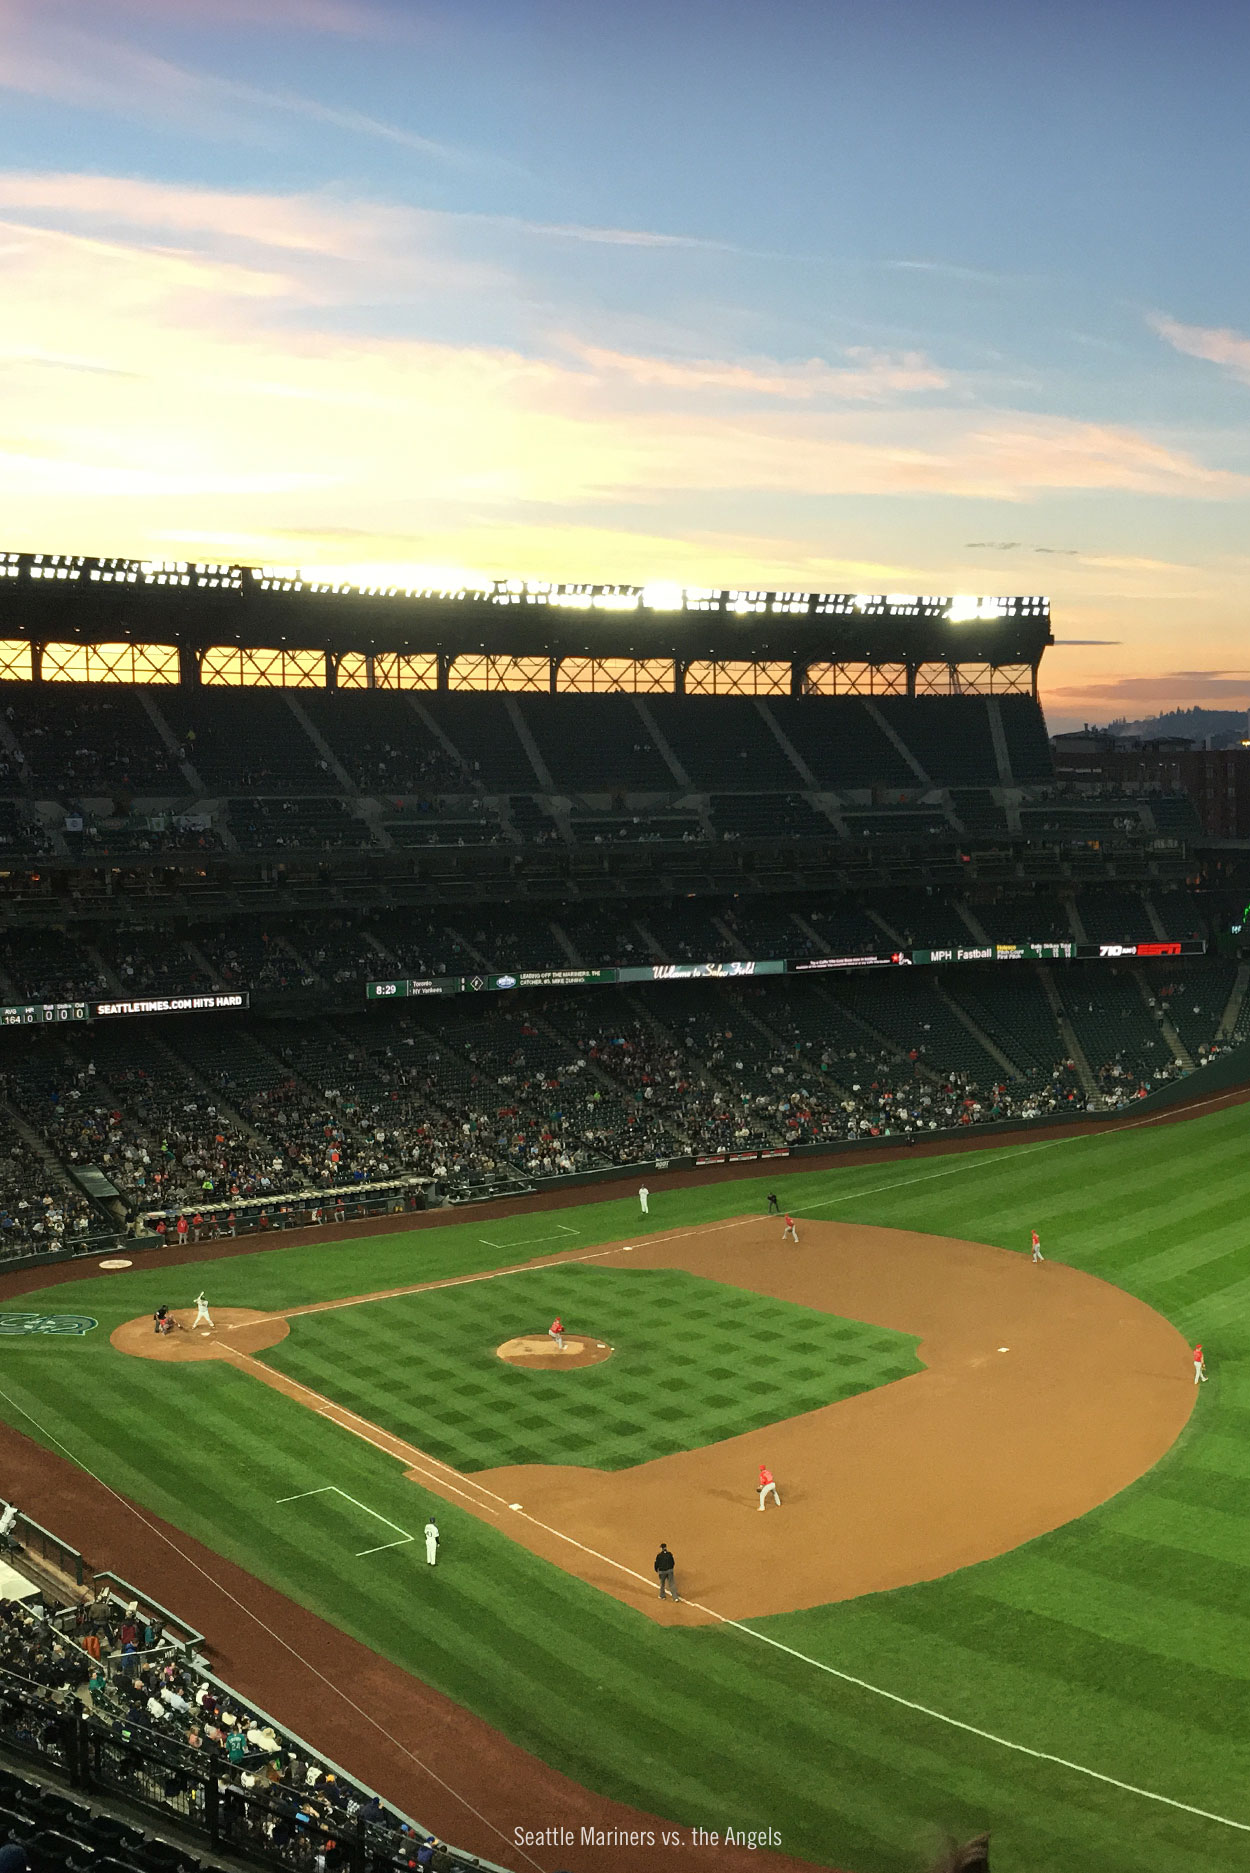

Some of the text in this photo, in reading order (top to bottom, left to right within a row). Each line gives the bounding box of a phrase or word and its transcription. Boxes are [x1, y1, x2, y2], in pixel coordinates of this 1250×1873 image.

[930, 948, 992, 962] MPH Fastball
[692, 968, 701, 978] to
[730, 961, 756, 976] Field
[376, 985, 397, 995] 8:29
[98, 996, 242, 1015] SEATTLETIMES.COM HITS HARD
[2, 1008, 83, 1025] .164 0 0 0 0
[231, 1742, 241, 1751] 24
